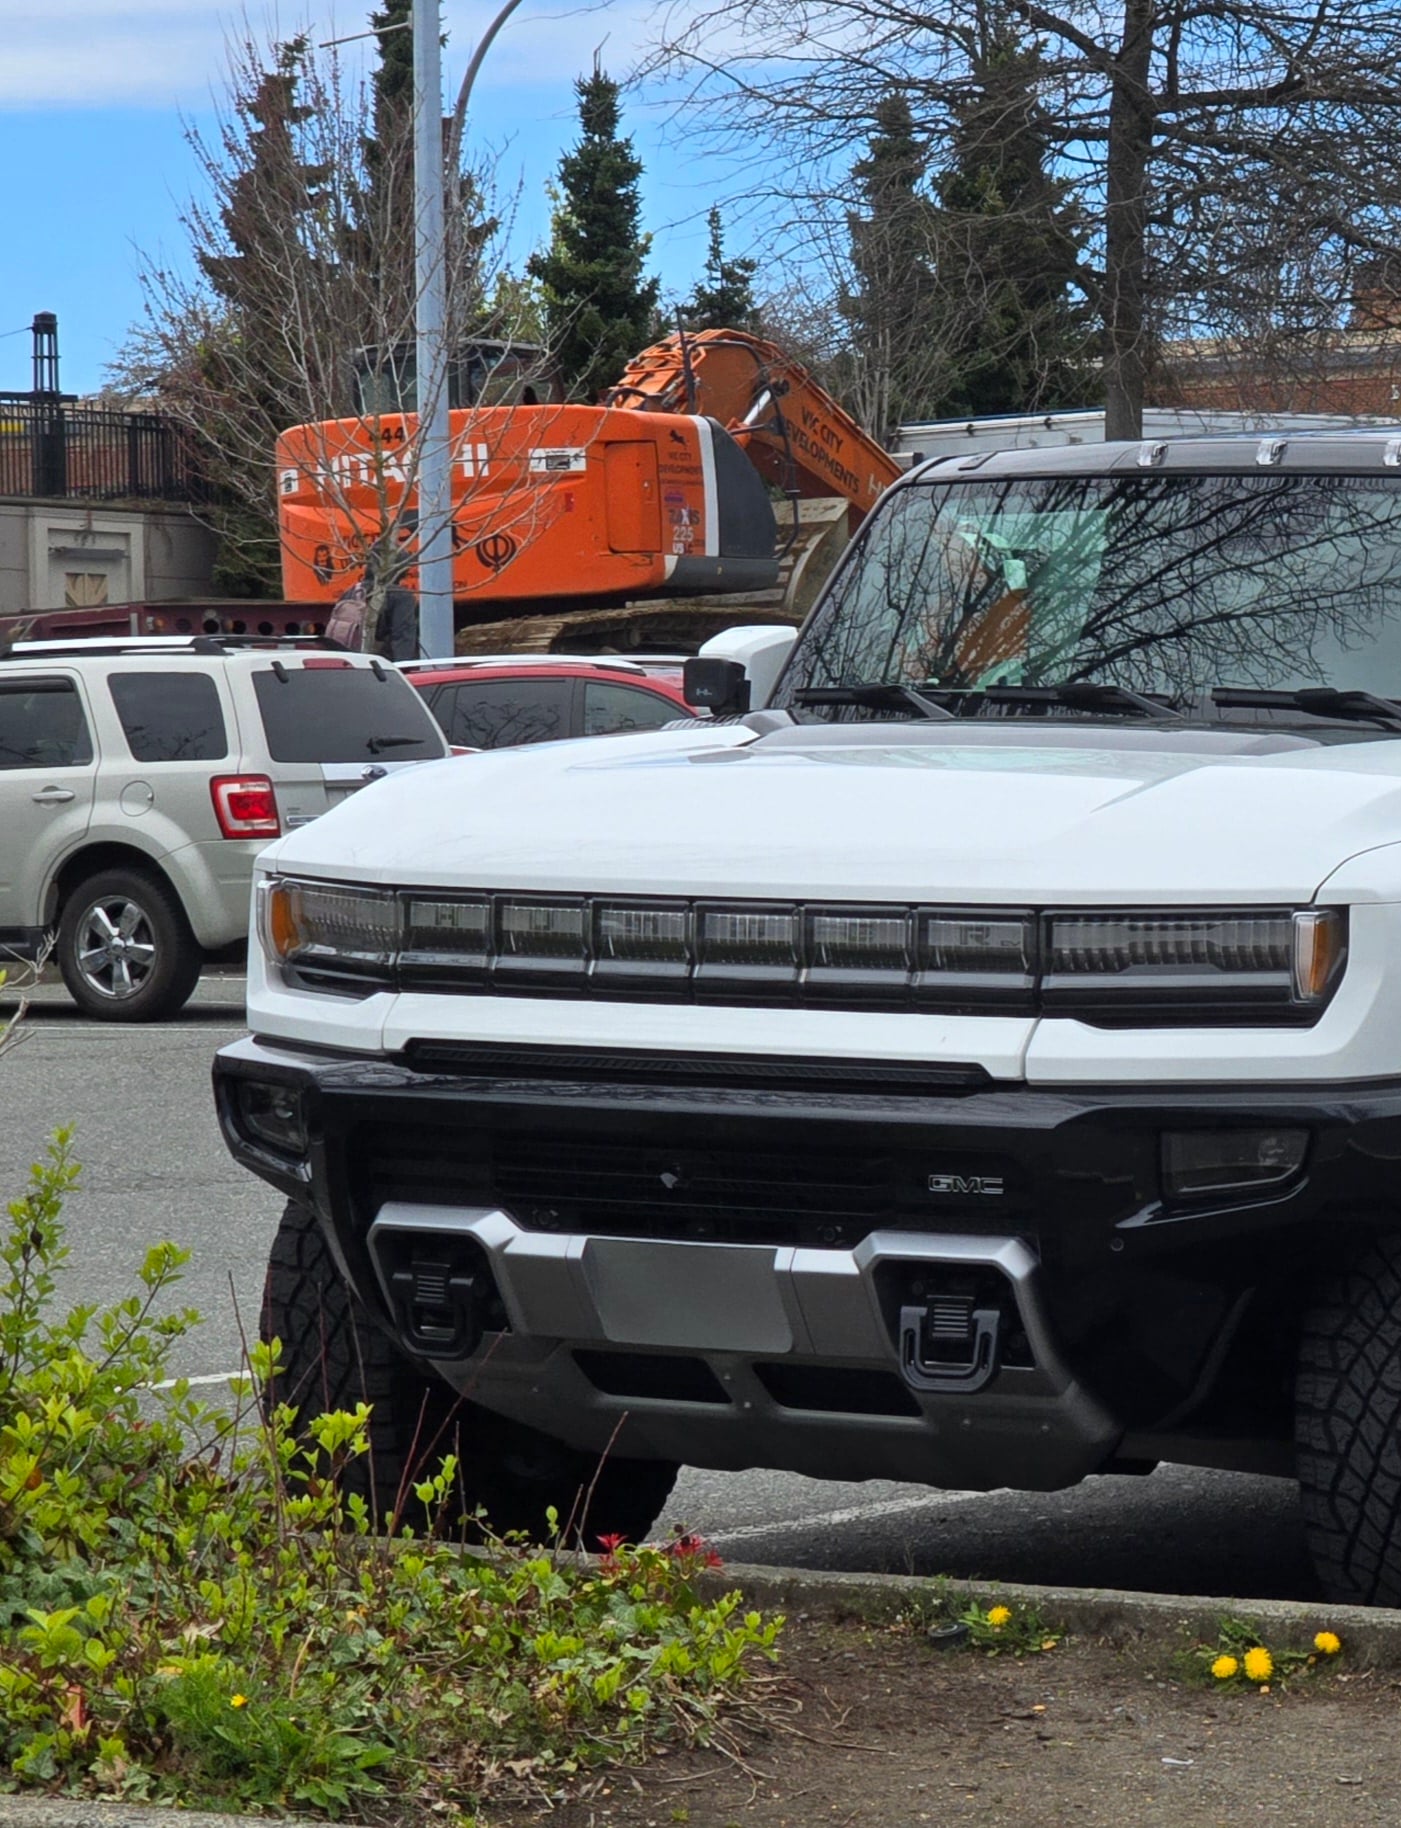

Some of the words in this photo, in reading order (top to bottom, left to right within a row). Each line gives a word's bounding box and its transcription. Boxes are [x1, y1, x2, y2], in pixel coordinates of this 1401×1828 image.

[821, 425, 844, 453] CITY
[785, 419, 861, 494] EVELOPMENTS
[673, 526, 694, 542] 225
[928, 1174, 1005, 1195] GMC
